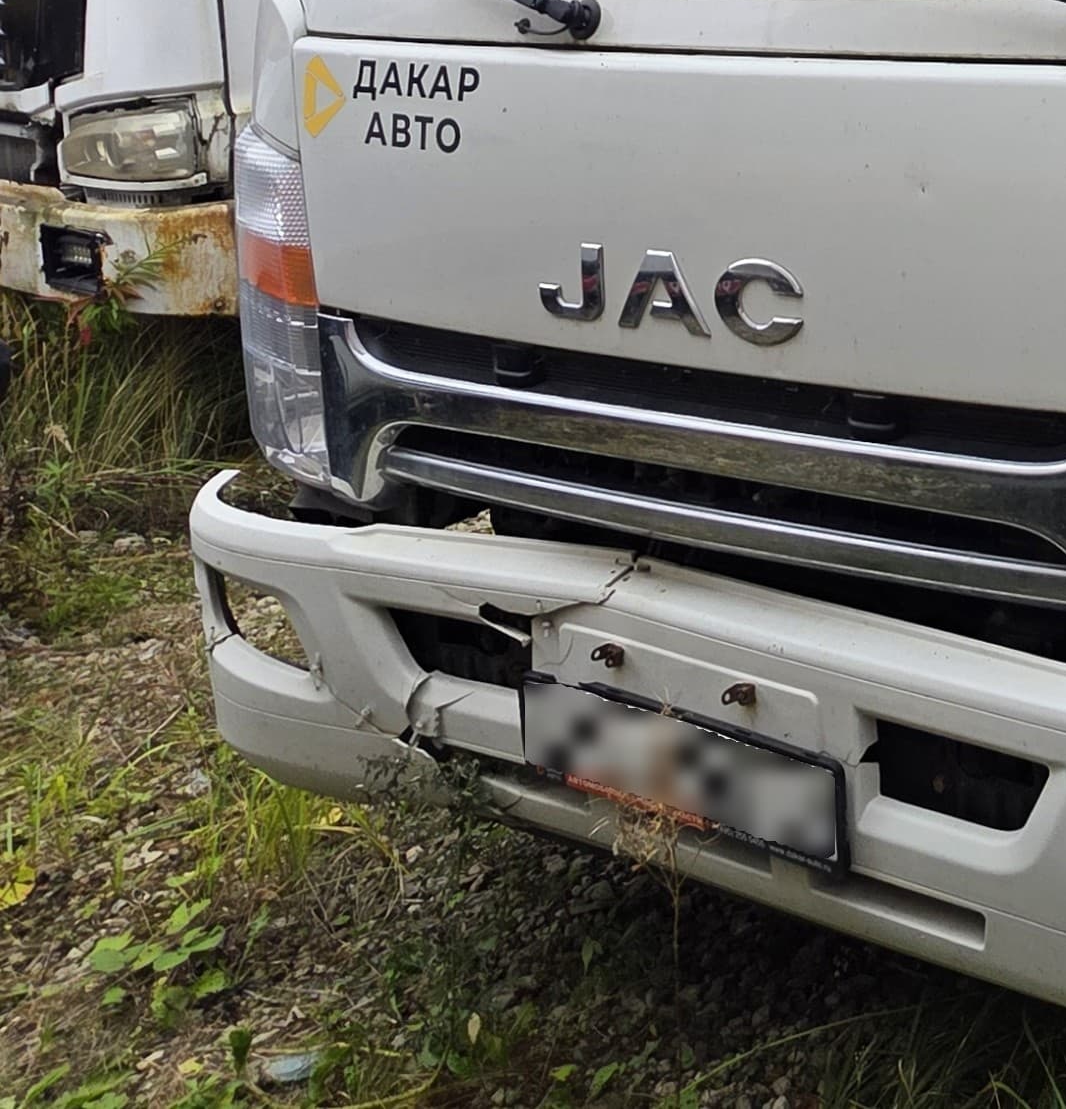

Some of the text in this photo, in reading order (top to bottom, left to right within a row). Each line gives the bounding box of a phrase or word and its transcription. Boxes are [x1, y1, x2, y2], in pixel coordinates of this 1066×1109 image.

[352, 59, 480, 102] ДАКАР
[364, 112, 462, 154] АВТО
[538, 242, 805, 347] JAC
